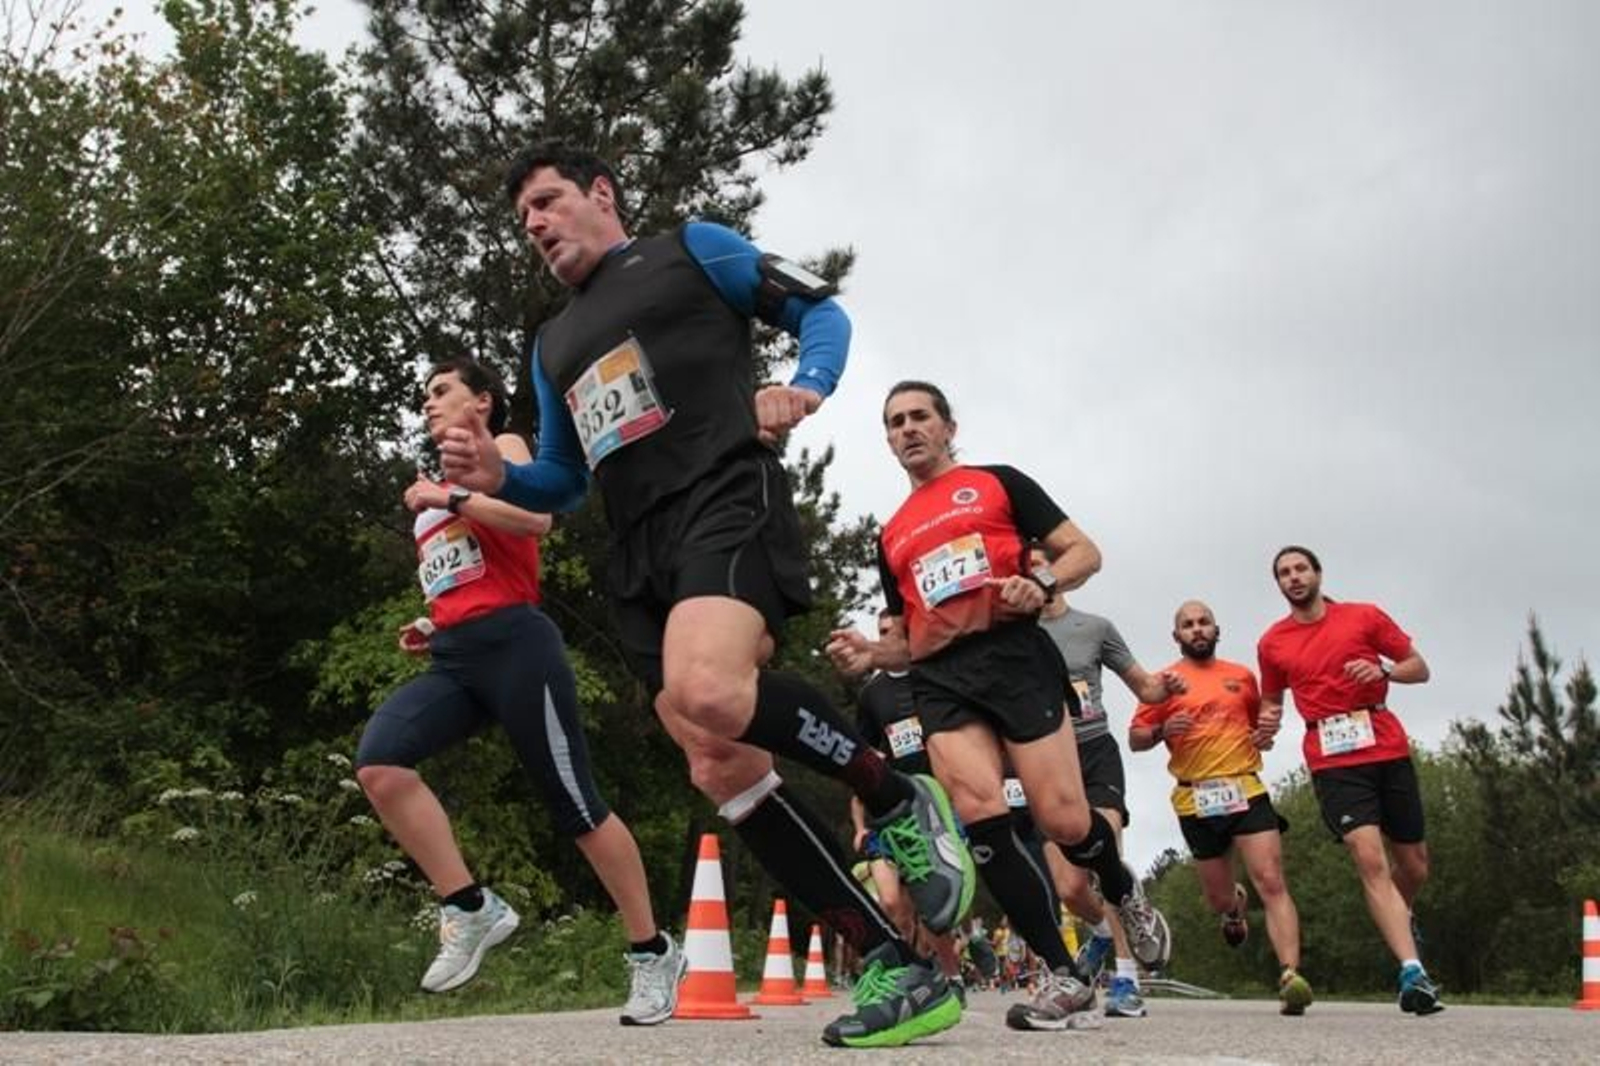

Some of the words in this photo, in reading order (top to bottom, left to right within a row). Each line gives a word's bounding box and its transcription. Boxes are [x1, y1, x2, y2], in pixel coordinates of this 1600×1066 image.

[580, 389, 627, 445] 352
[425, 547, 462, 585] 692
[922, 557, 967, 593] 647
